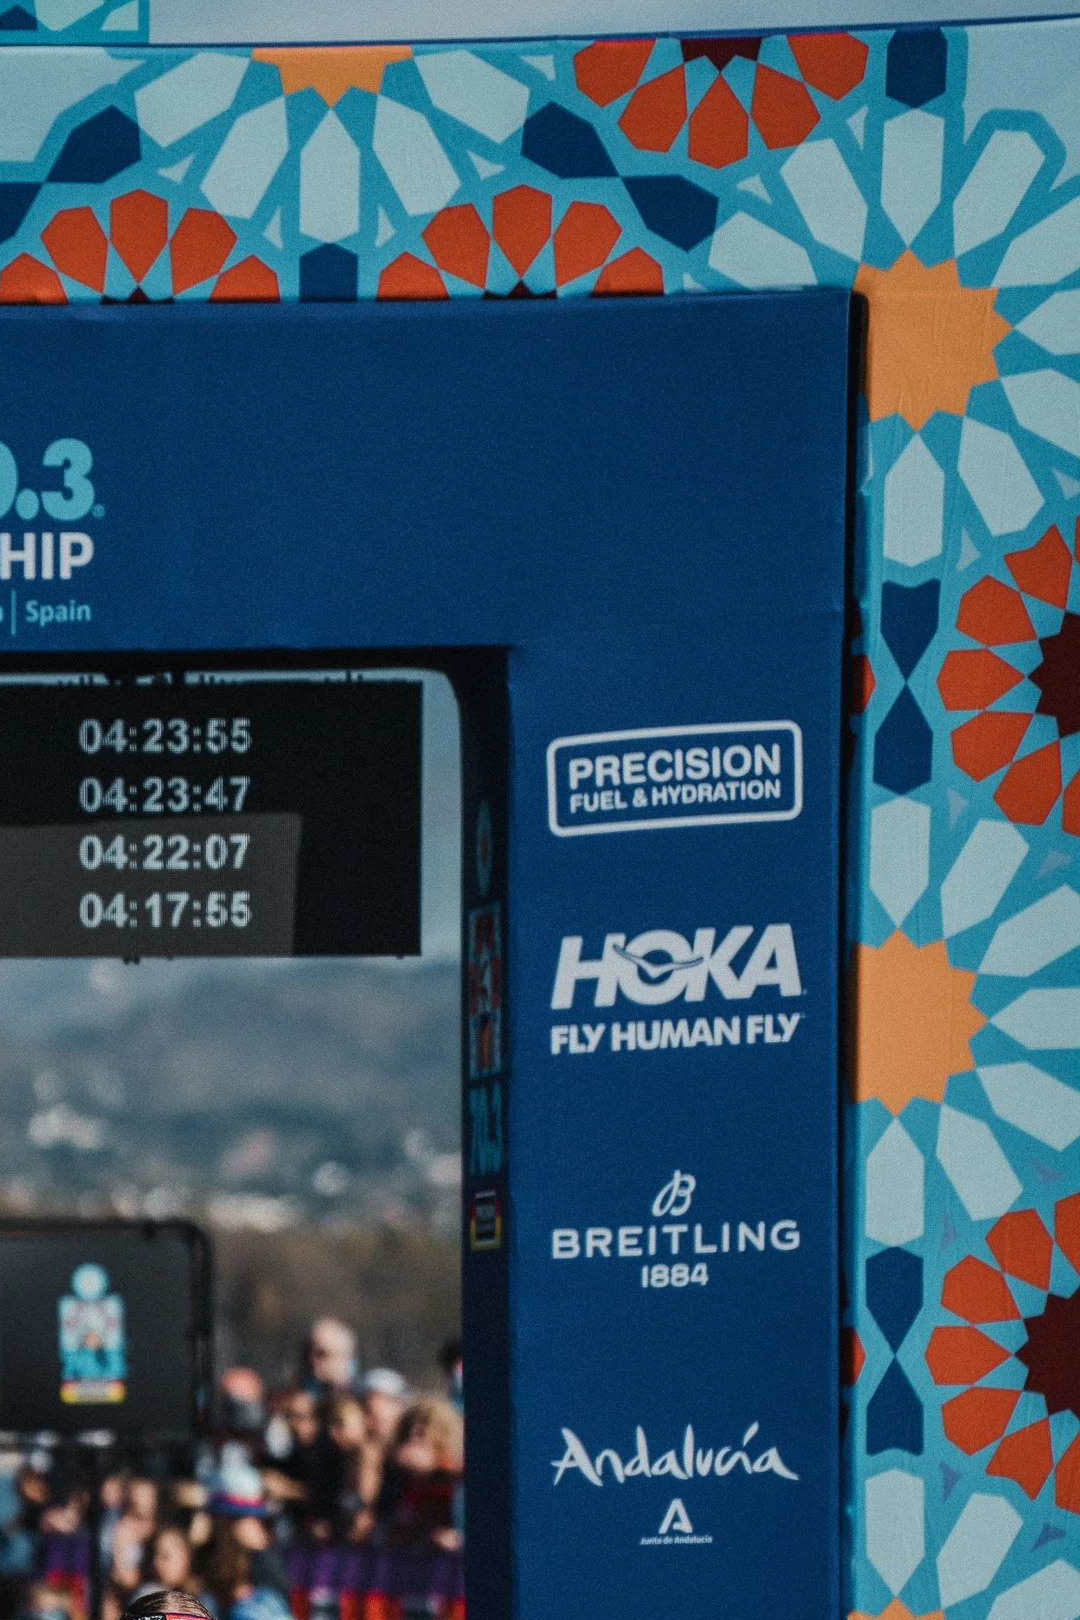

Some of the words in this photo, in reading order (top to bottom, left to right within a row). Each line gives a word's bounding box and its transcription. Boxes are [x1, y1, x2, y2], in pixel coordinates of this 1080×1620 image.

[24, 599, 93, 628] Spain
[78, 717, 252, 754] 04:23:55
[568, 743, 781, 790] PRECISION
[78, 778, 252, 813] 04:23:47
[569, 789, 628, 814] FUEL
[632, 789, 648, 808] &
[652, 778, 781, 806] HYDRATION
[78, 834, 252, 870] 04:22:07
[78, 892, 252, 928] 04:17:55
[550, 922, 803, 1010] HOKA
[550, 1022, 606, 1055] FLY
[611, 1015, 740, 1052] HUMAN
[746, 1012, 801, 1045] FLY
[551, 1219, 801, 1260] BREITLING
[641, 1263, 710, 1288] 1884
[550, 1420, 800, 1487] Andalucía
